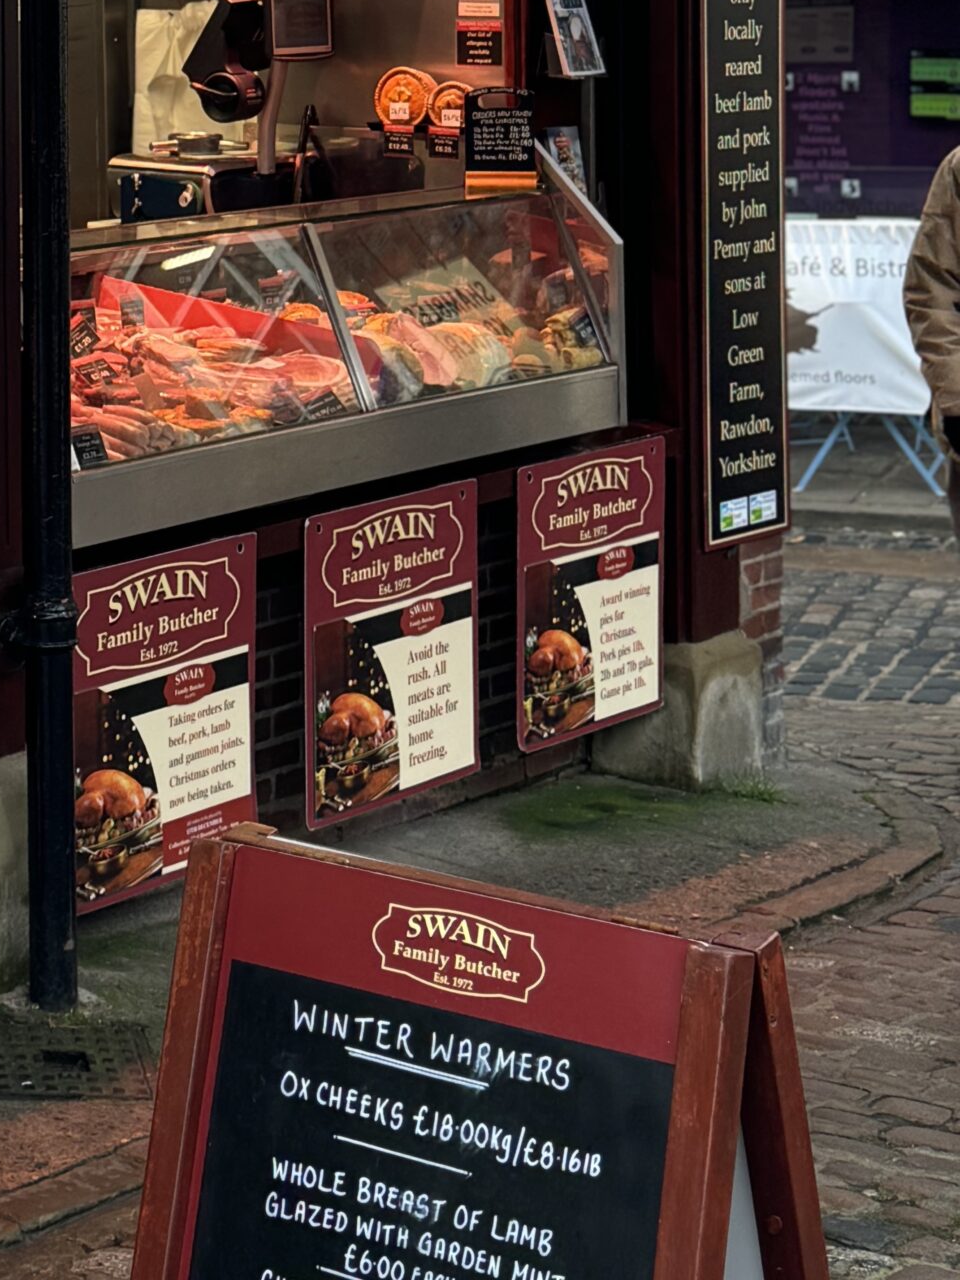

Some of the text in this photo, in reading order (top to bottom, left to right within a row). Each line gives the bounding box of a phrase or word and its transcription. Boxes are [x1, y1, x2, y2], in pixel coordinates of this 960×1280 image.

[724, 19, 763, 46] locally
[725, 54, 762, 76] reared
[715, 89, 772, 114] beef lamb
[717, 125, 771, 155] and pork
[718, 161, 770, 192] supplied
[721, 198, 767, 228] by John
[714, 231, 775, 263] Penny and
[789, 256, 906, 277] afé & Bistr
[724, 271, 766, 295] sons at
[732, 308, 759, 330] Low
[727, 344, 764, 367] Green
[729, 381, 764, 403] Farm,
[834, 370, 876, 385] floors
[720, 414, 774, 442] Rawdon,
[719, 449, 776, 479] Yorkshire
[557, 464, 629, 507] SWAIN
[549, 497, 637, 531] Family Butcher
[351, 512, 436, 560] SWAIN
[342, 547, 446, 585] Family Butcher
[109, 569, 208, 624] SWAIN
[97, 606, 219, 652] Family Butcher
[407, 641, 449, 665] Avoid the
[407, 660, 447, 685] rush. All
[407, 682, 451, 706] meats are
[168, 698, 236, 729] Taking orders for
[407, 698, 459, 727] suitable for
[168, 720, 231, 748] beef, pork, lamb
[408, 728, 434, 747] home
[168, 753, 184, 768] and
[185, 744, 219, 764] gammon
[408, 744, 448, 768] freezing.
[169, 759, 236, 788] Christmas orders
[169, 778, 234, 809] now being taken.
[406, 913, 511, 960] SWAIN
[392, 939, 520, 983] Family Butcher
[433, 971, 474, 991] Est. 1972
[293, 999, 571, 1090] WINTER WARMERS
[280, 1070, 312, 1101] OX
[316, 1081, 403, 1131] CHEEKS
[271, 1157, 554, 1257] WHOLE BREAST OF LAMB
[265, 1192, 502, 1280] GLAZED WITH GARDEN
